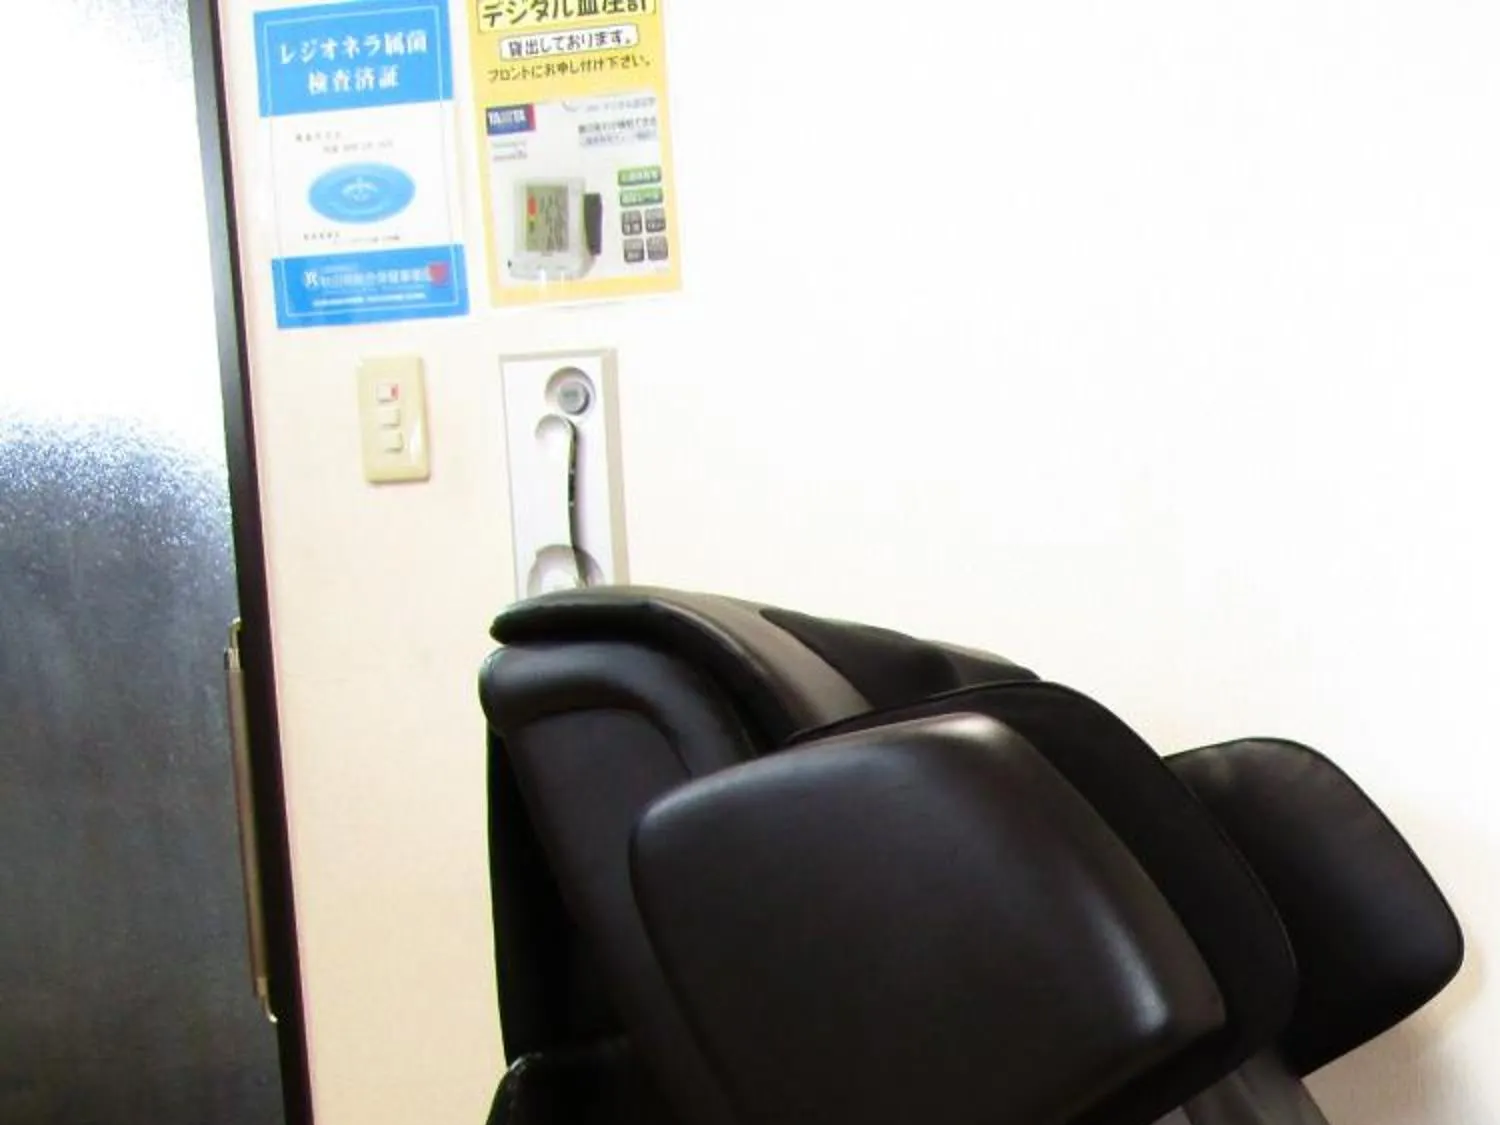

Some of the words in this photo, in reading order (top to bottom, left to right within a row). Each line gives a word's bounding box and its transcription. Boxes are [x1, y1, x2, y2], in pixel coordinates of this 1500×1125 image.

[508, 29, 632, 57] 貸出しております。
[488, 54, 652, 83] フロントにお申し付け下さい。
